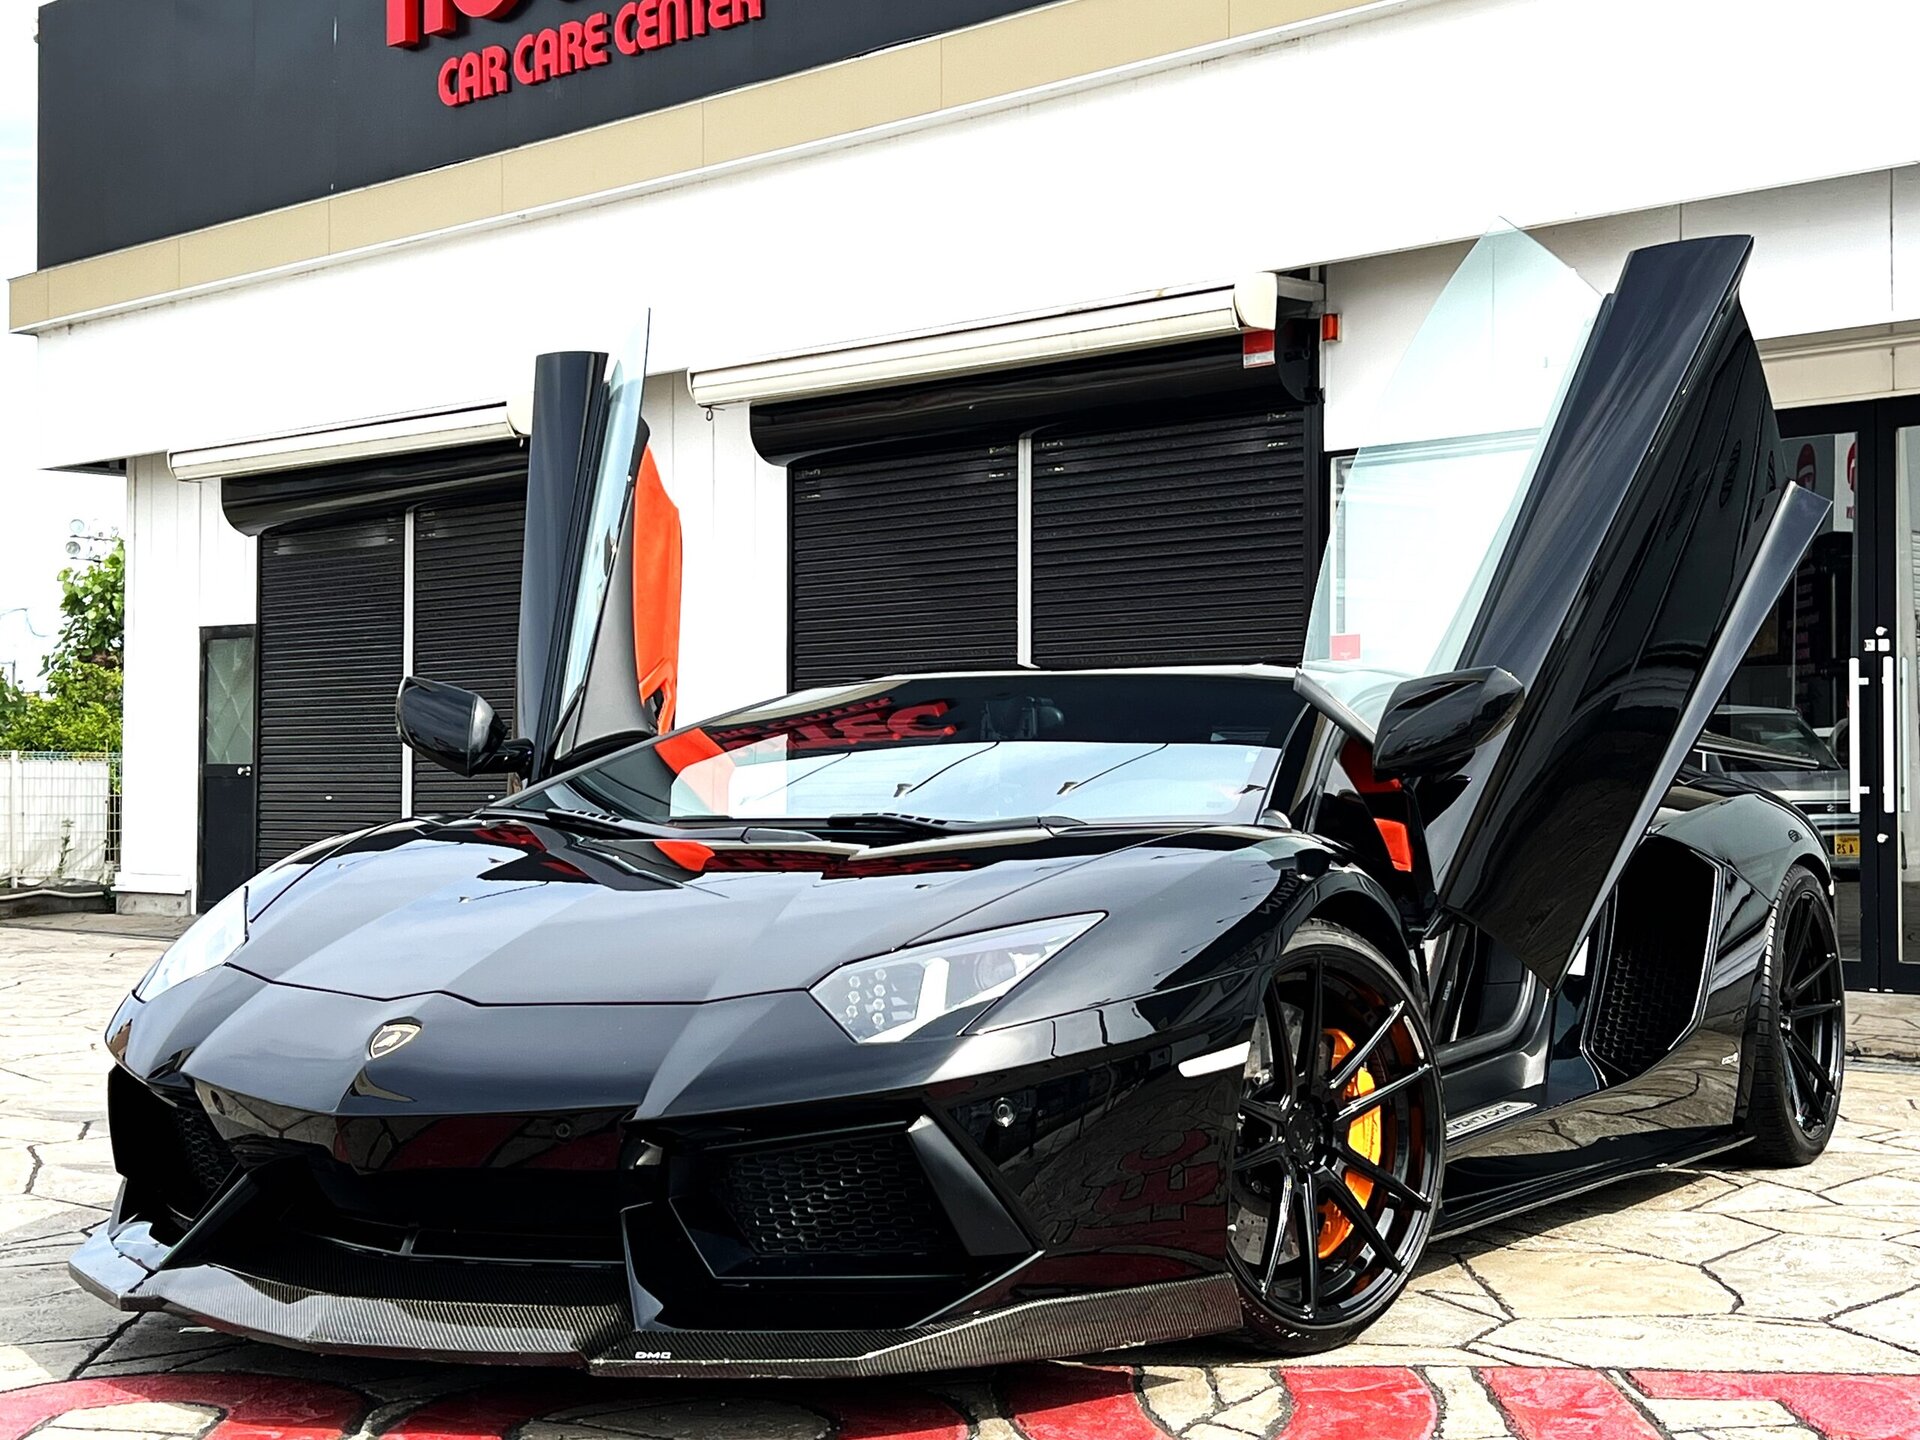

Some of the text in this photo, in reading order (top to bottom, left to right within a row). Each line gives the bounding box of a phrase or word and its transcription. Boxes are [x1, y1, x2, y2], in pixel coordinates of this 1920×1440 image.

[438, 45, 508, 107] CAR
[513, 12, 608, 86] CARE
[614, 0, 762, 55] CENTER
